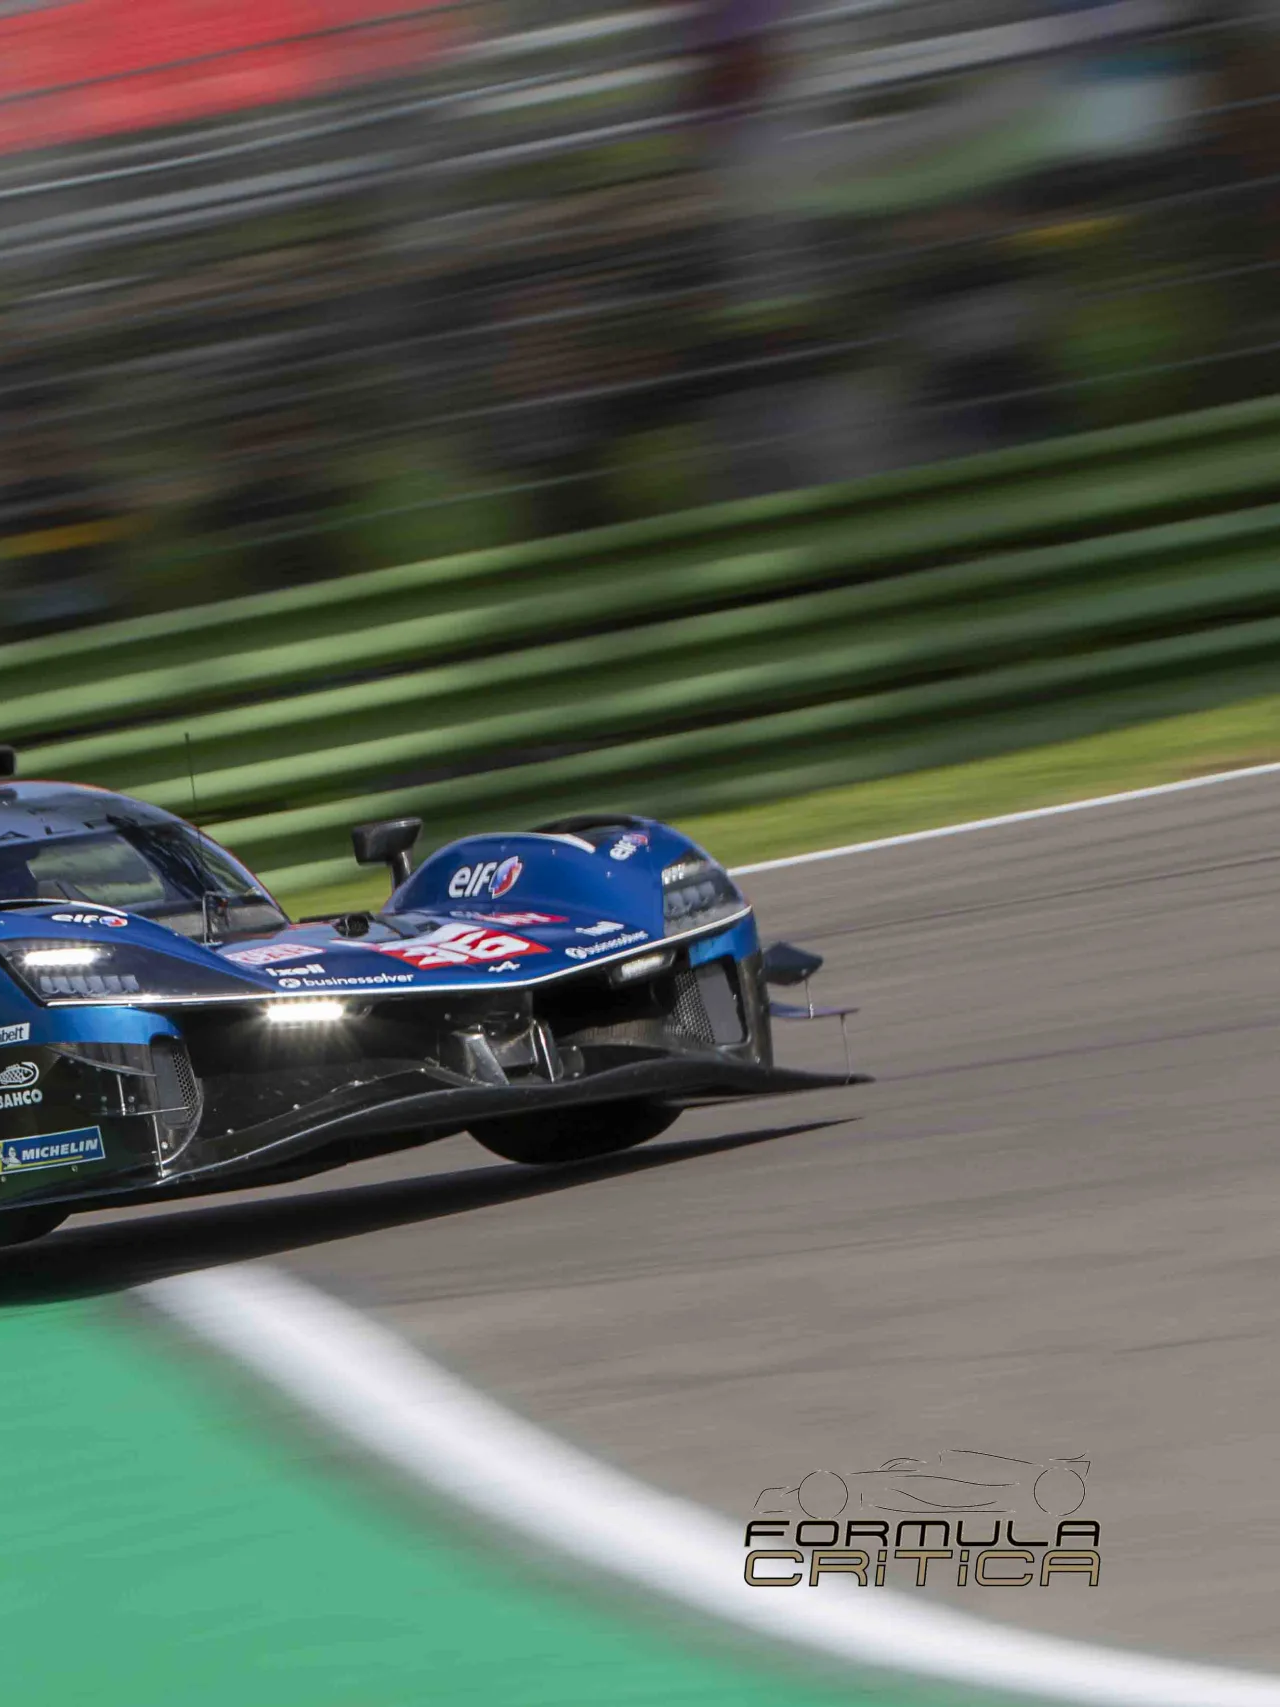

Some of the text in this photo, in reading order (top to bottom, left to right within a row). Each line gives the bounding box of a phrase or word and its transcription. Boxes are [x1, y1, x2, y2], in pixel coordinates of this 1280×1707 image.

[448, 862, 497, 898] elf
[51, 914, 101, 924] elf
[302, 972, 414, 987] businessolver
[21, 1137, 99, 1161] MICHELIN
